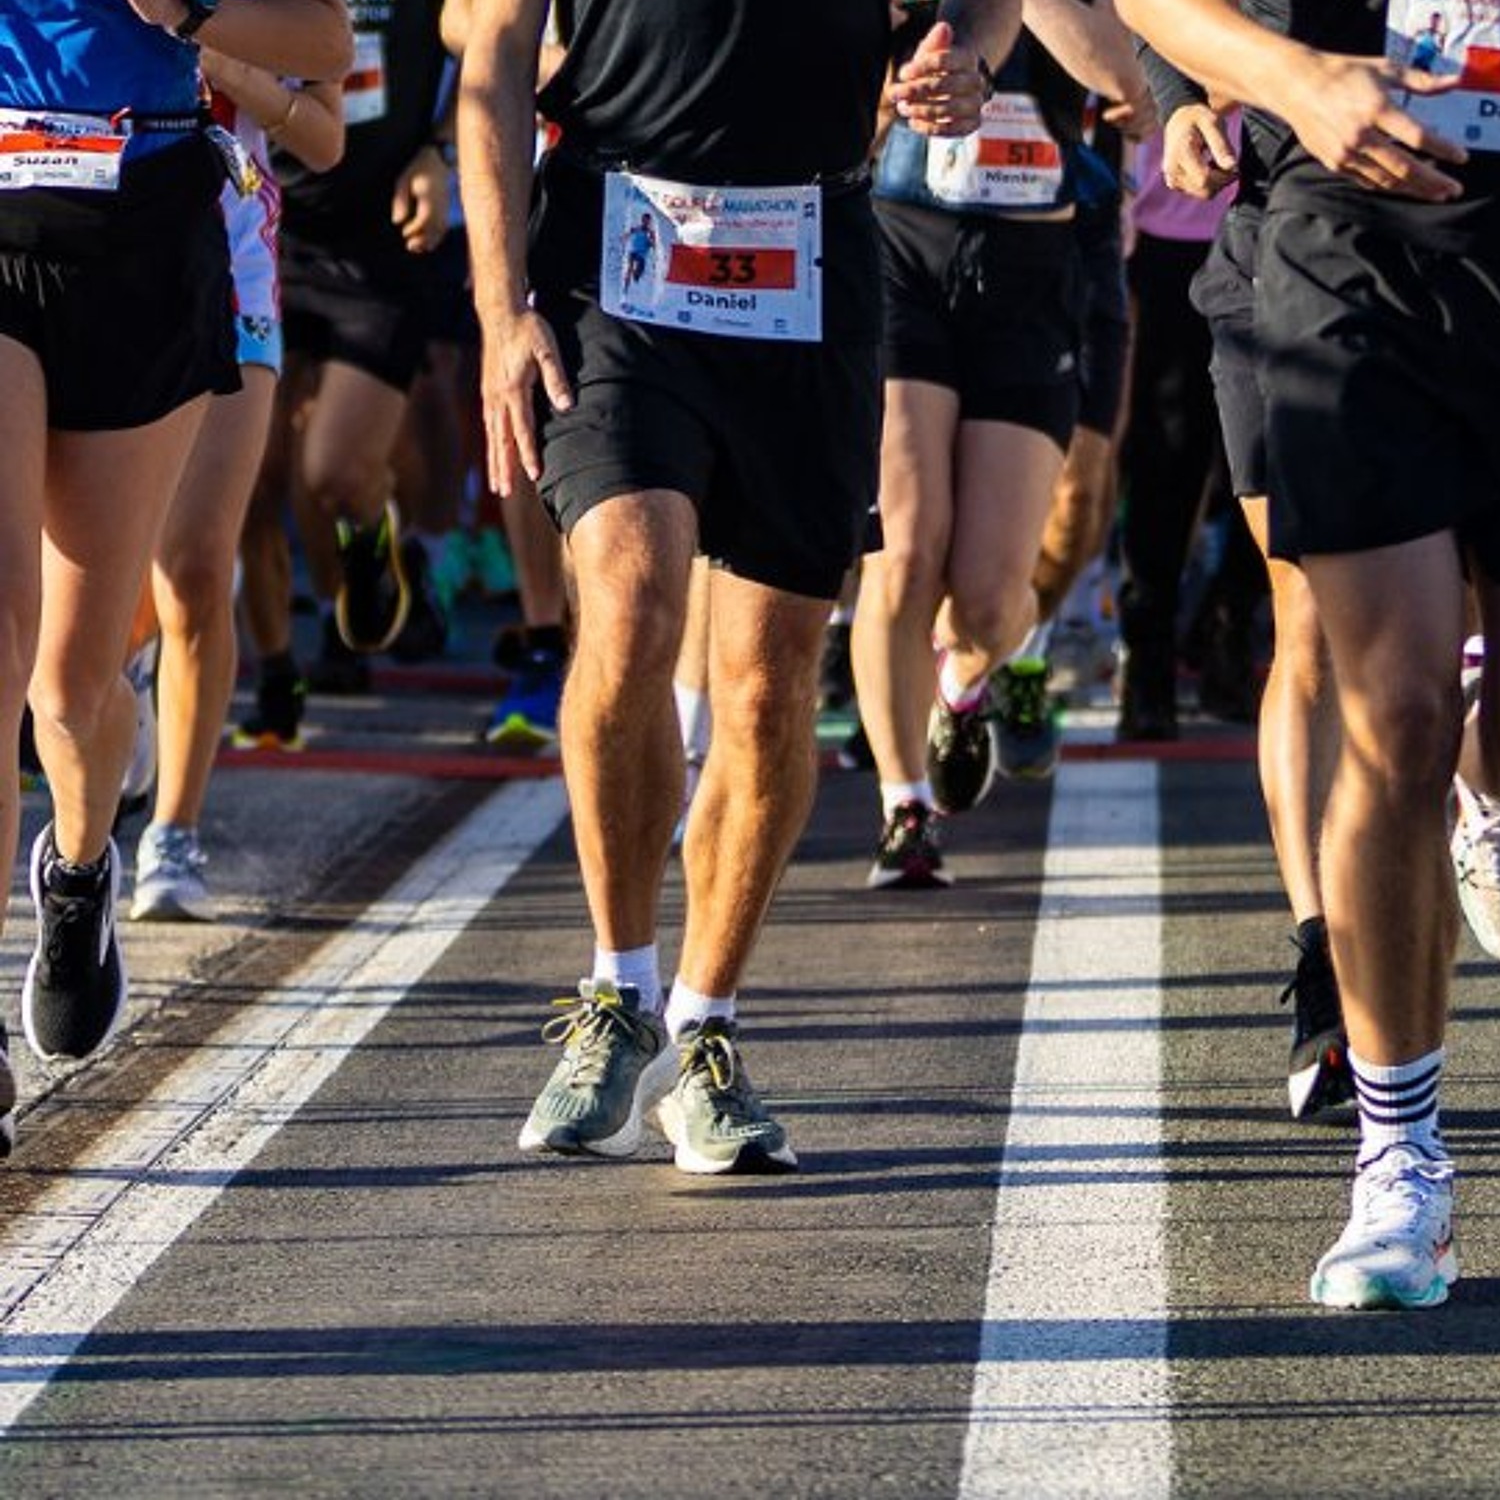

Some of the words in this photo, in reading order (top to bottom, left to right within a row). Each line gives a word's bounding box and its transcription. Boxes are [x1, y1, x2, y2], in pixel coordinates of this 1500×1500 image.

[1007, 142, 1034, 165] 51
[722, 199, 798, 213] MARATHON
[709, 253, 757, 284] 33
[686, 290, 757, 311] Daniel
